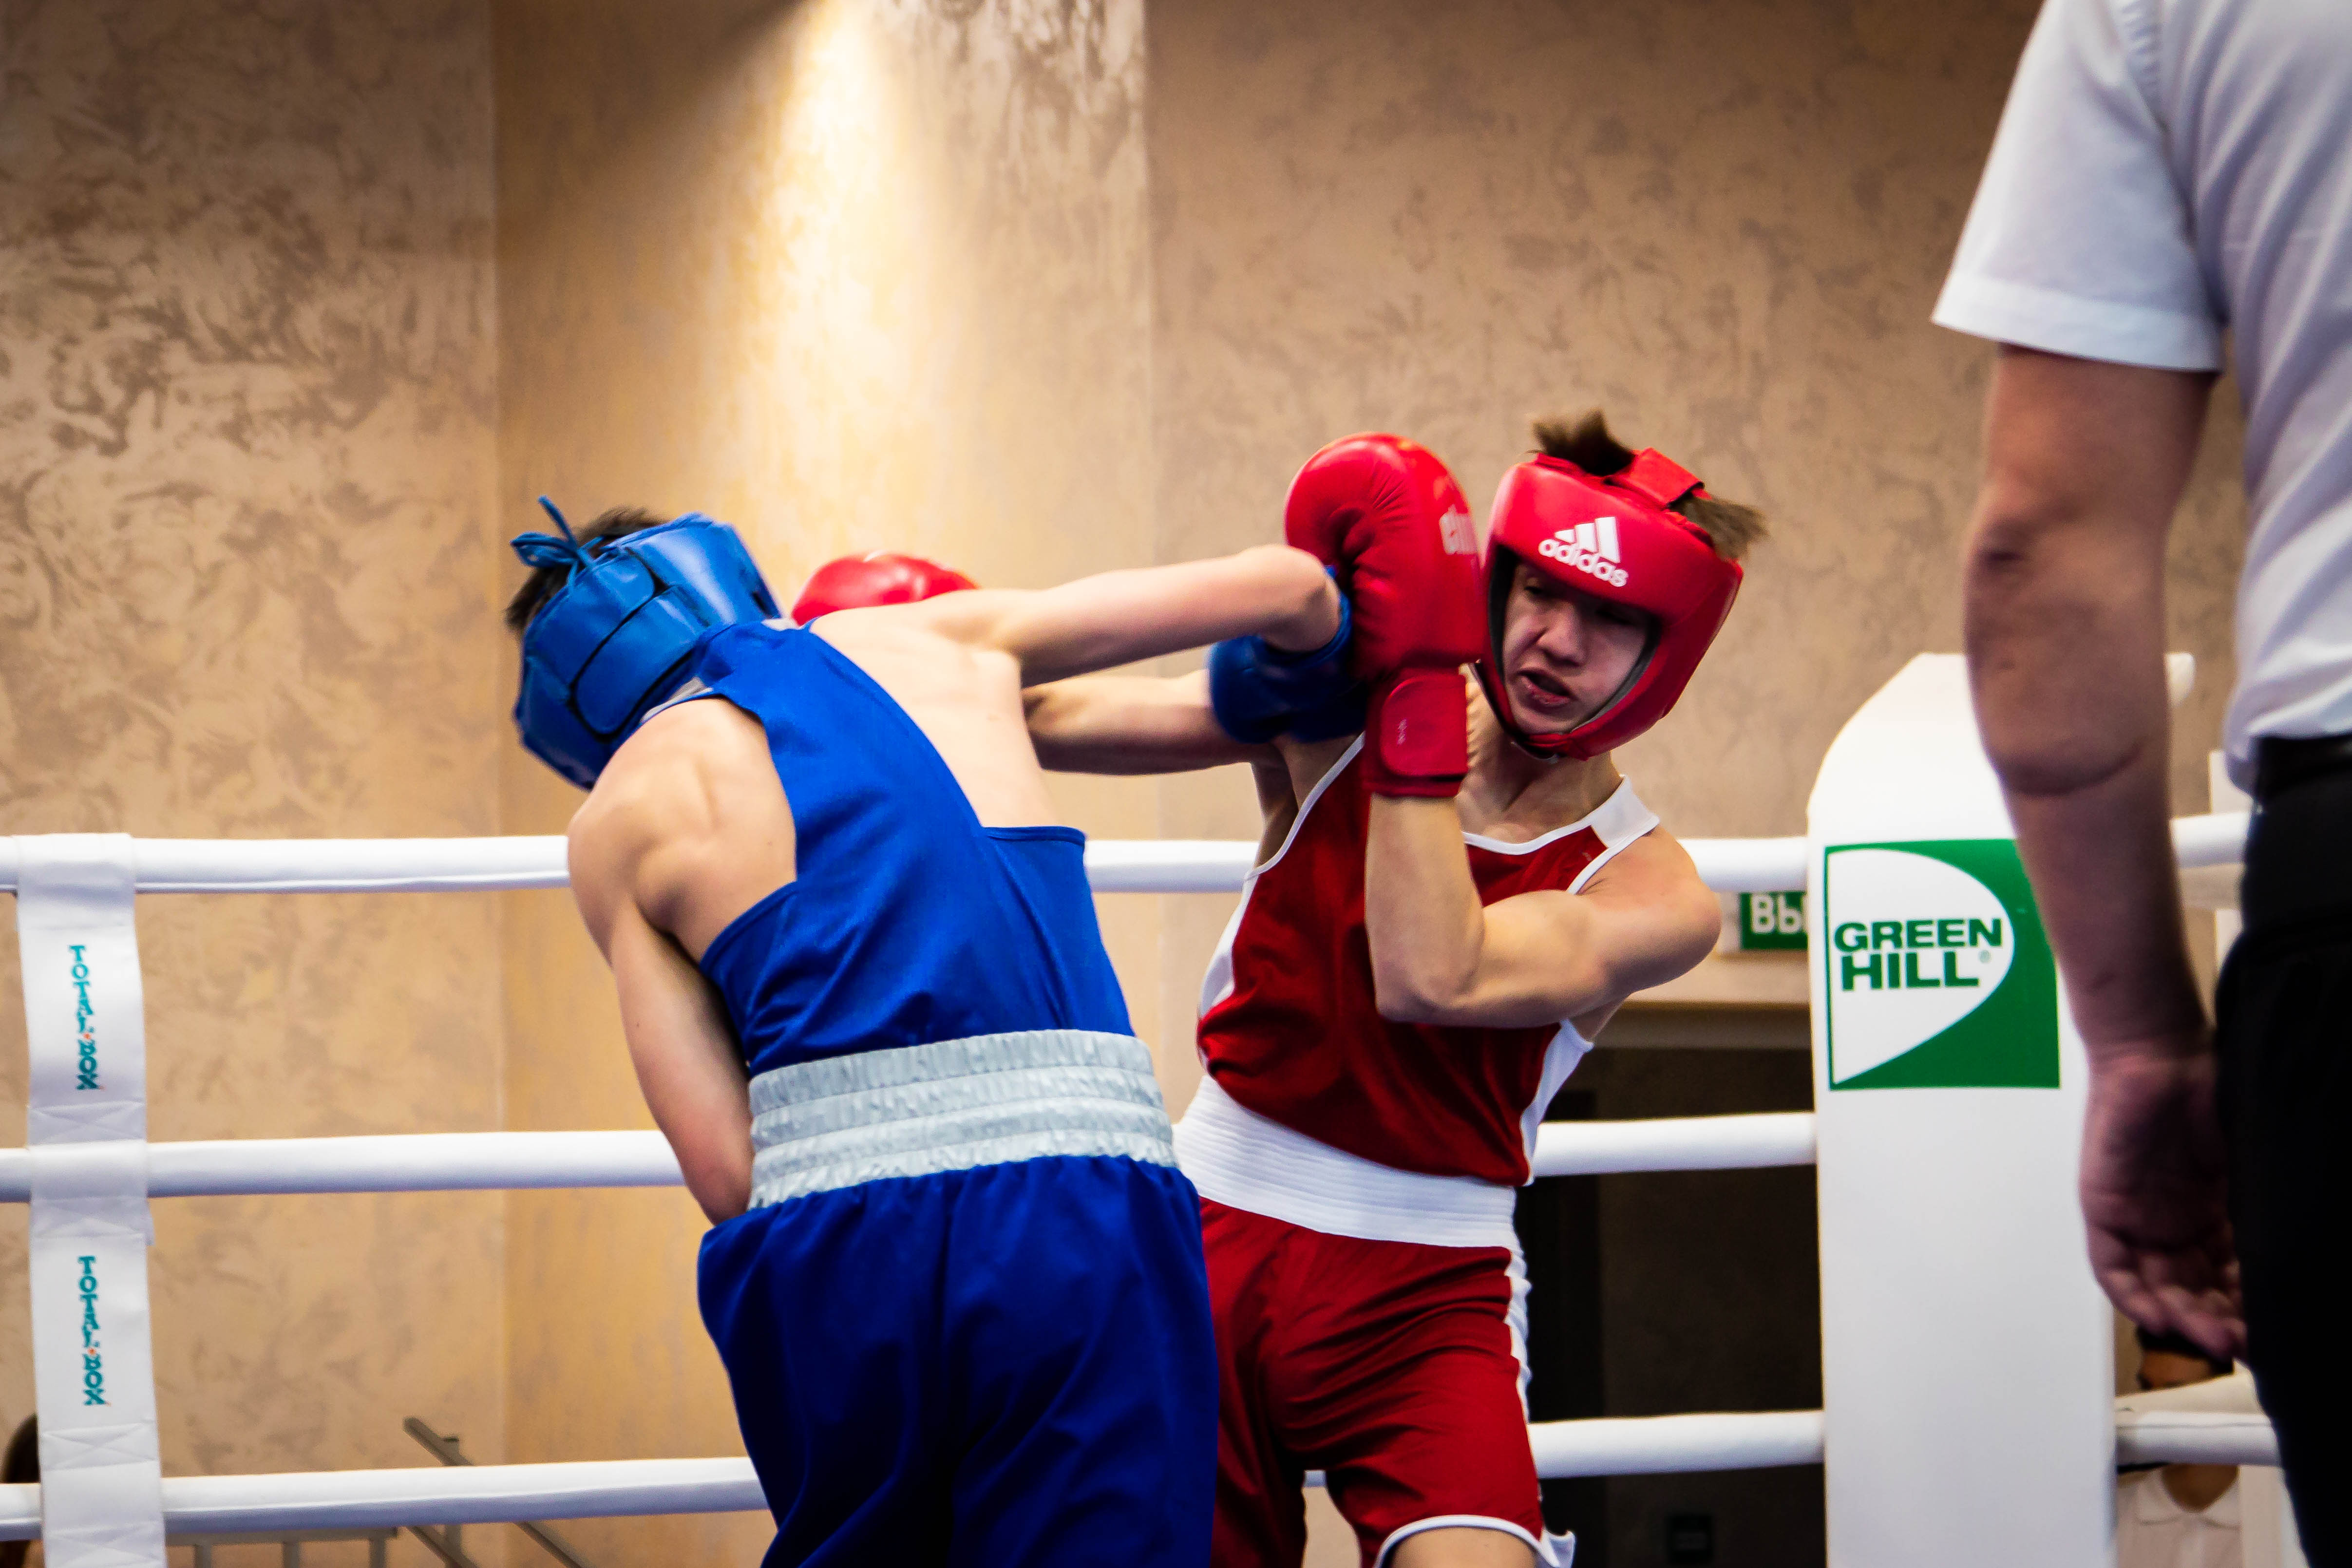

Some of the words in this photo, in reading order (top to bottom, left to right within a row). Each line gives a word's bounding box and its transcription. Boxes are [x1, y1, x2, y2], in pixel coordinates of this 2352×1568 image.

[1538, 538, 1629, 587] adidas
[1834, 918, 2002, 952] GREEN
[1841, 952, 1979, 991] HILL
